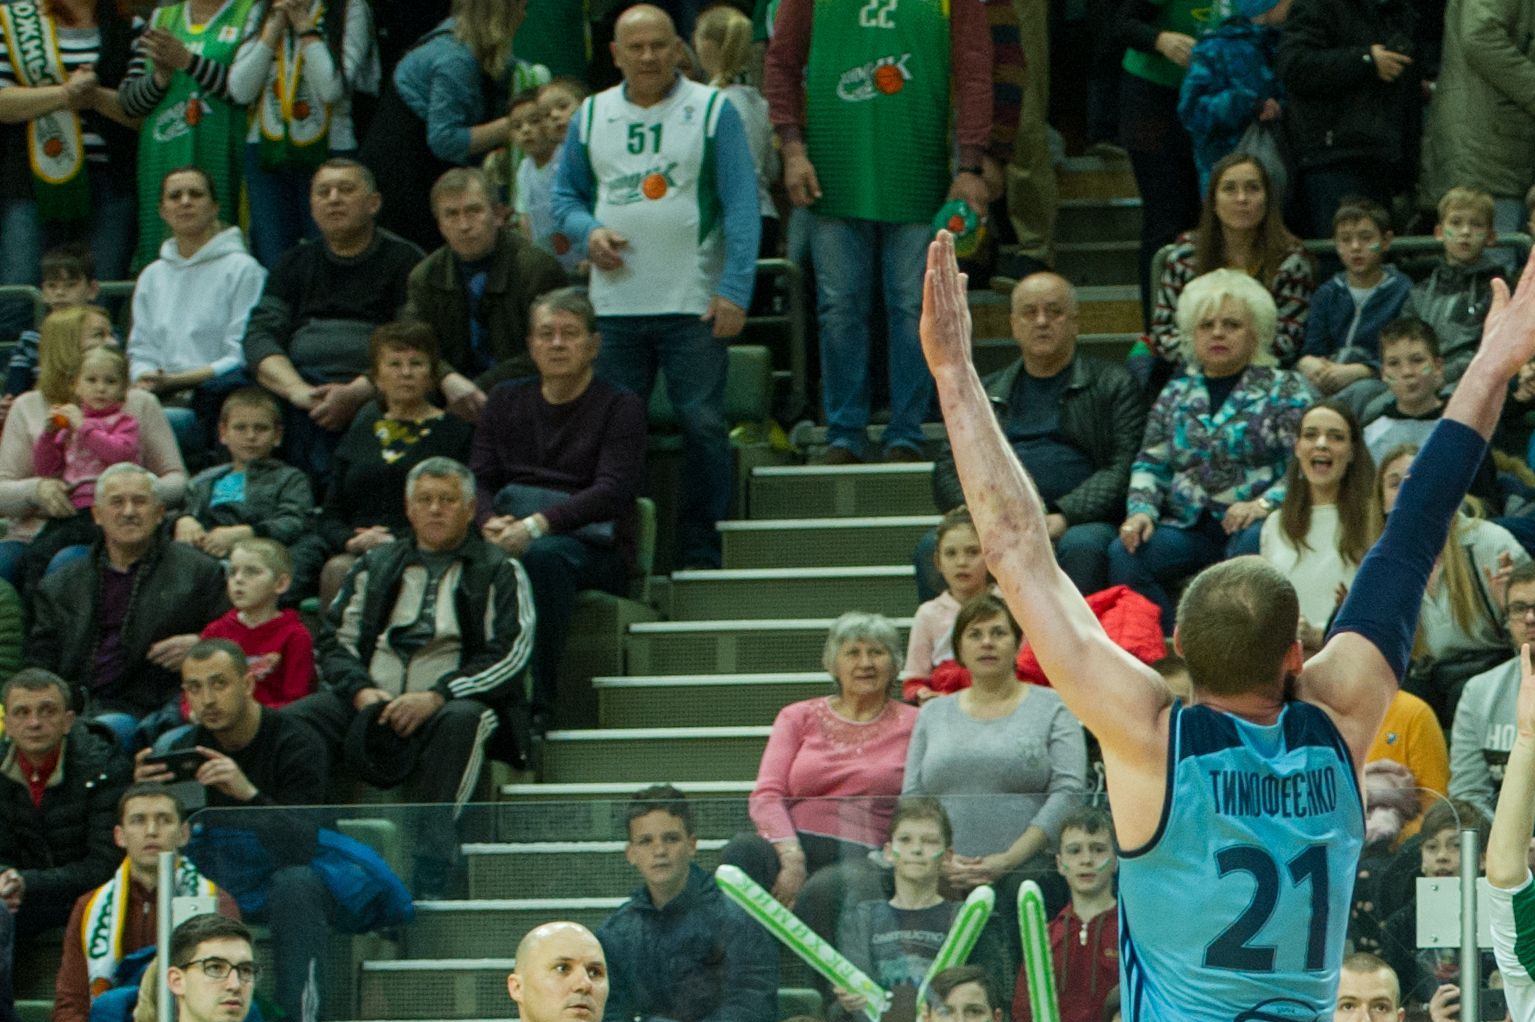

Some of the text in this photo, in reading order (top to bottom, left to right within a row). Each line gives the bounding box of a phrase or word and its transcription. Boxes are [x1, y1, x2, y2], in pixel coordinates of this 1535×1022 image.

[859, 0, 898, 28] 22
[627, 122, 663, 155] 51
[1202, 843, 1329, 973] 21
